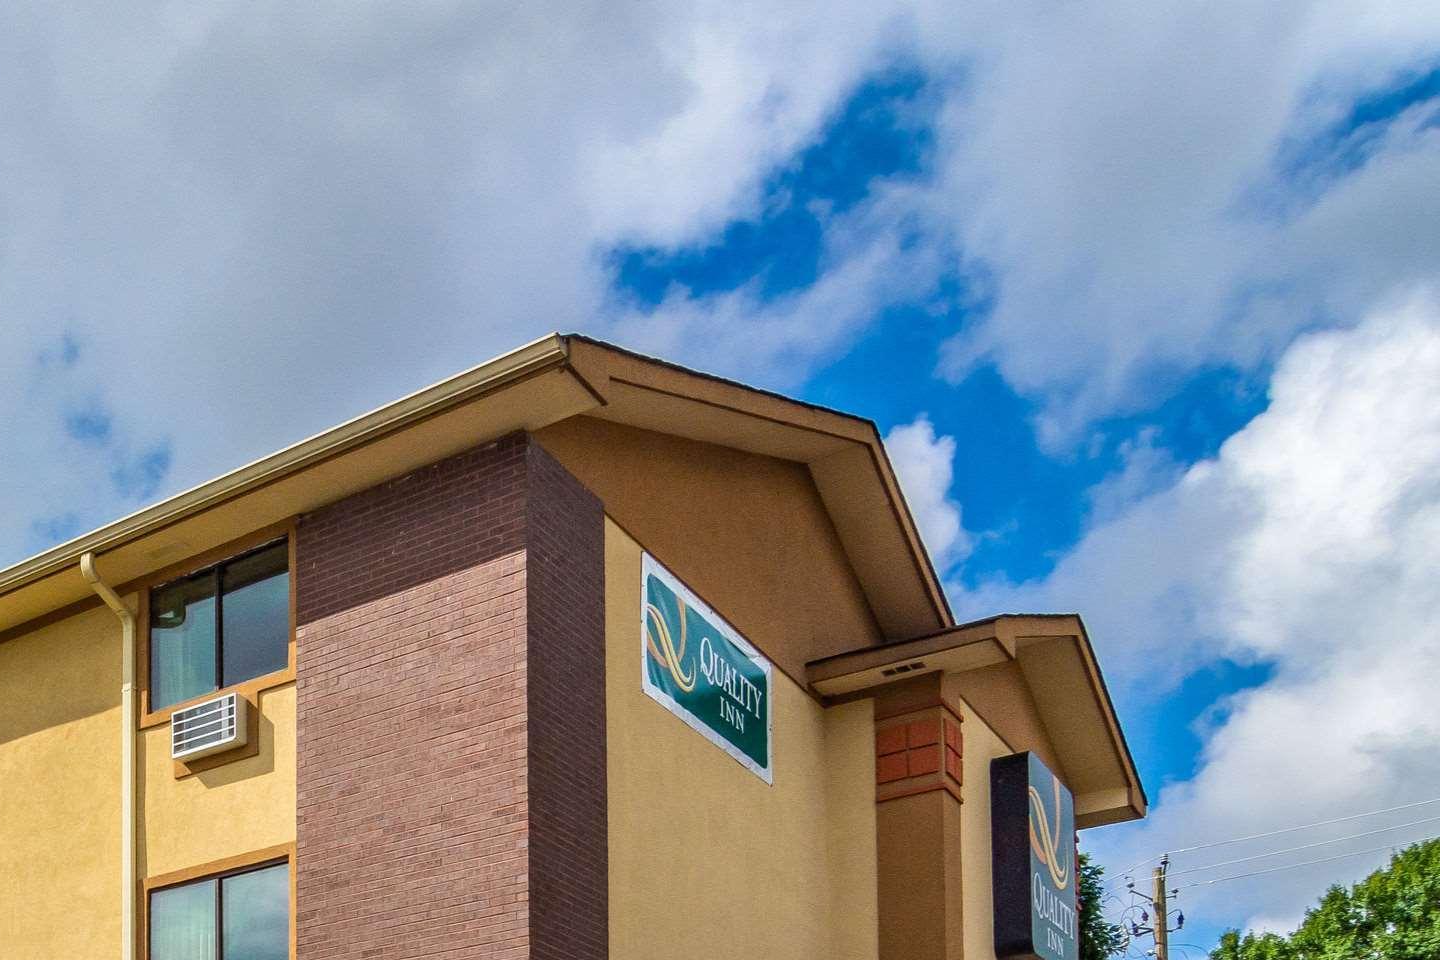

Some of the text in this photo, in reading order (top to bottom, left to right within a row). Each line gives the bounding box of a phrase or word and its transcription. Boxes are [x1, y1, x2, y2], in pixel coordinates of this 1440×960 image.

[700, 637, 762, 720] QUALITY
[720, 696, 744, 734] INN
[1034, 872, 1075, 940] QUALITY
[1047, 928, 1064, 957] INN
